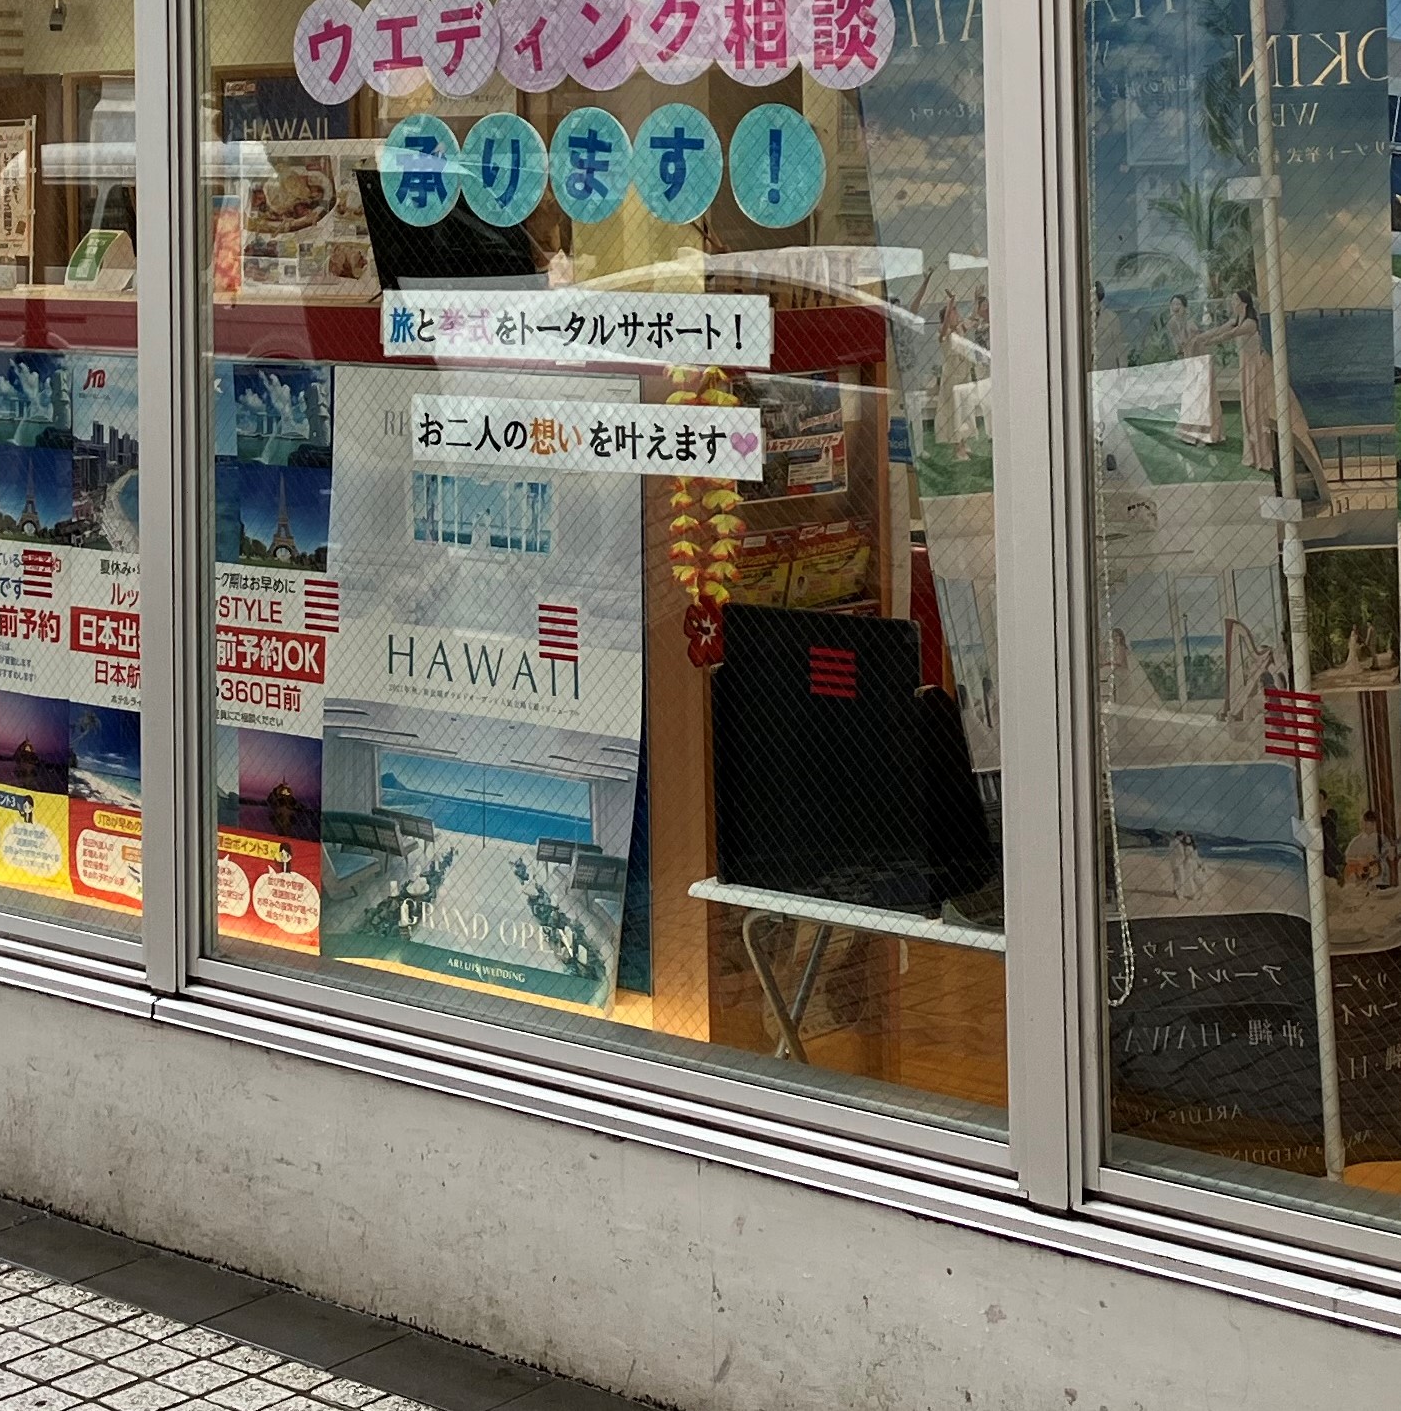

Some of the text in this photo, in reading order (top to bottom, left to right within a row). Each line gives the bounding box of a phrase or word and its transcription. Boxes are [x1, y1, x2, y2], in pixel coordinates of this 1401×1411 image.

[83, 368, 106, 390] JTB
[100, 559, 140, 576] 夏休み・
[215, 595, 283, 624] STYLE
[79, 613, 140, 653] 日本出
[216, 678, 301, 713] 360日前
[401, 897, 489, 942] GRAND
